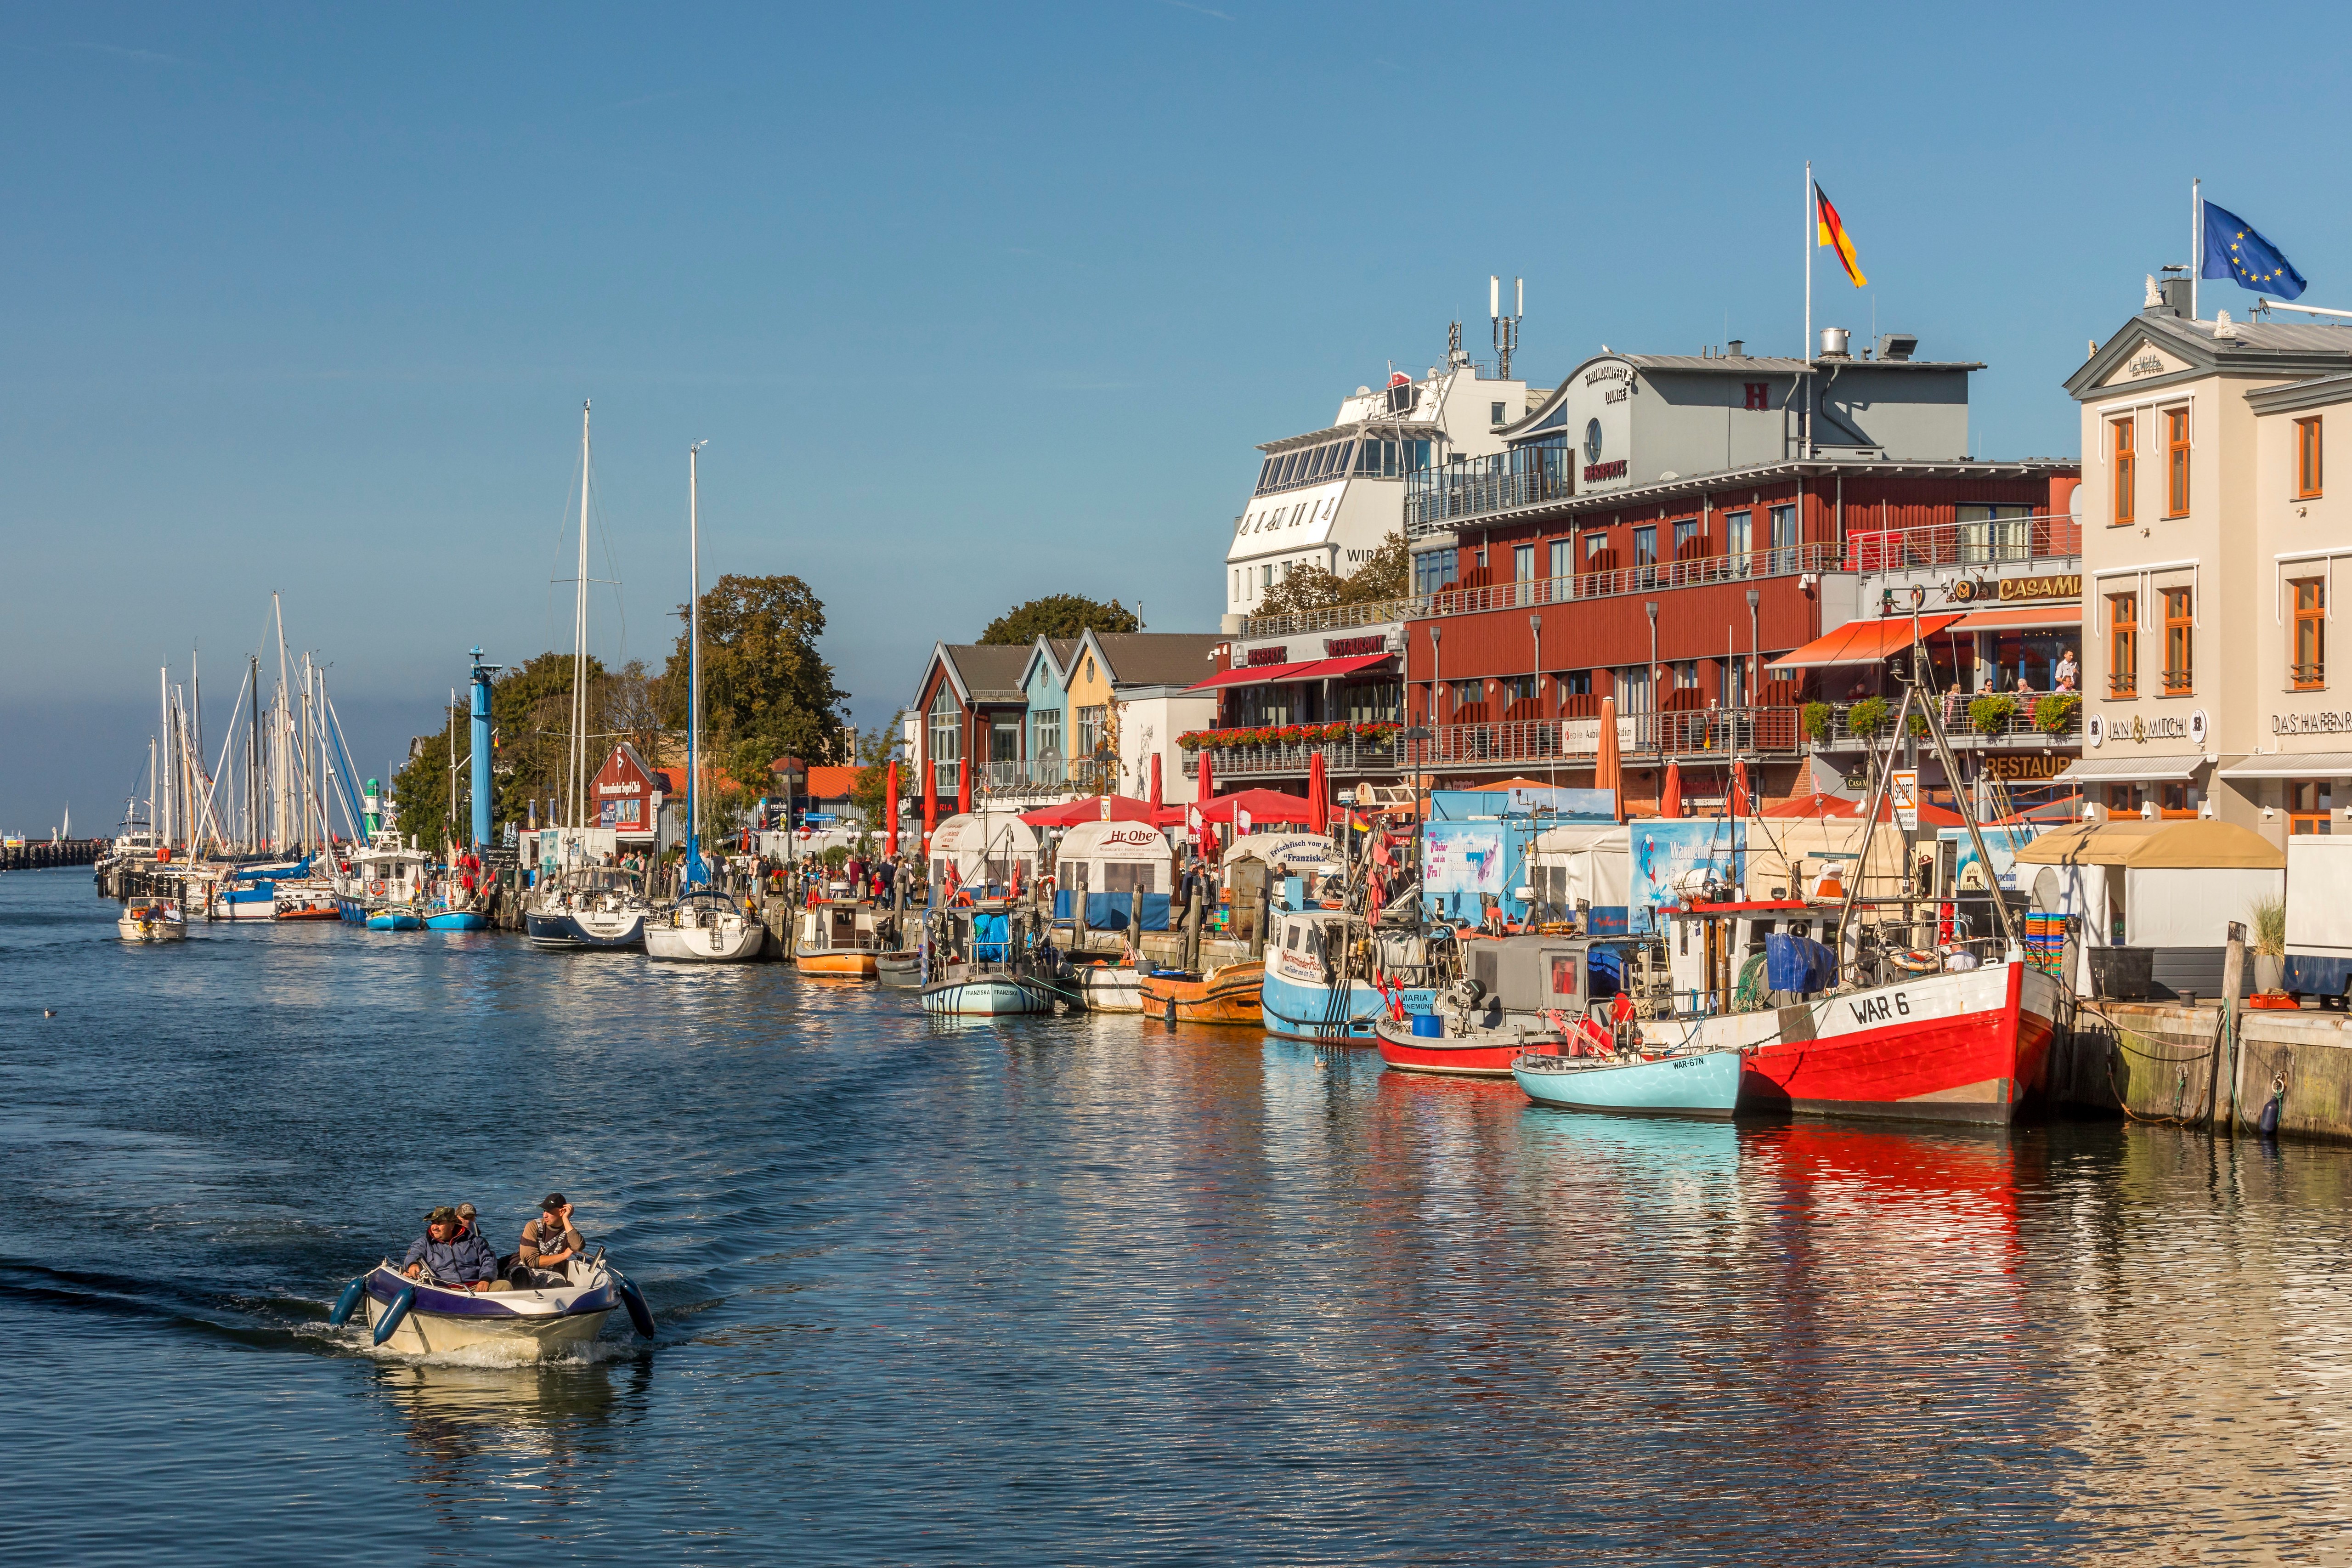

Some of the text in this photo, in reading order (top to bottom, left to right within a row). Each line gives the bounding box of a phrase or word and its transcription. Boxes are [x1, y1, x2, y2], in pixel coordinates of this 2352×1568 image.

[1584, 367, 1625, 385] STROMDAMPFER
[1605, 388, 1625, 403] LOUNGE
[1744, 383, 1769, 409] H
[1584, 459, 1625, 481] HERBERTS
[1329, 634, 1383, 657] RESTAURANT
[1247, 646, 1285, 666] HERBERTS
[2108, 714, 2185, 742] JAN & MITCH
[2272, 712, 2352, 733] DAS HAFENR
[1985, 757, 2081, 777] RESTAUR
[1895, 784, 1913, 799] SPORT
[1111, 830, 1159, 843] Hr. Ober
[1189, 834, 1201, 843] EIS
[1270, 840, 1306, 858] Frischfisch
[1430, 840, 1447, 853] Fischer
[1448, 841, 1485, 854] Warnemünder
[1448, 858, 1477, 872] Fischmarkt
[1849, 992, 1910, 1025] WAR 6
[1673, 1057, 1704, 1070] WAR-67N
